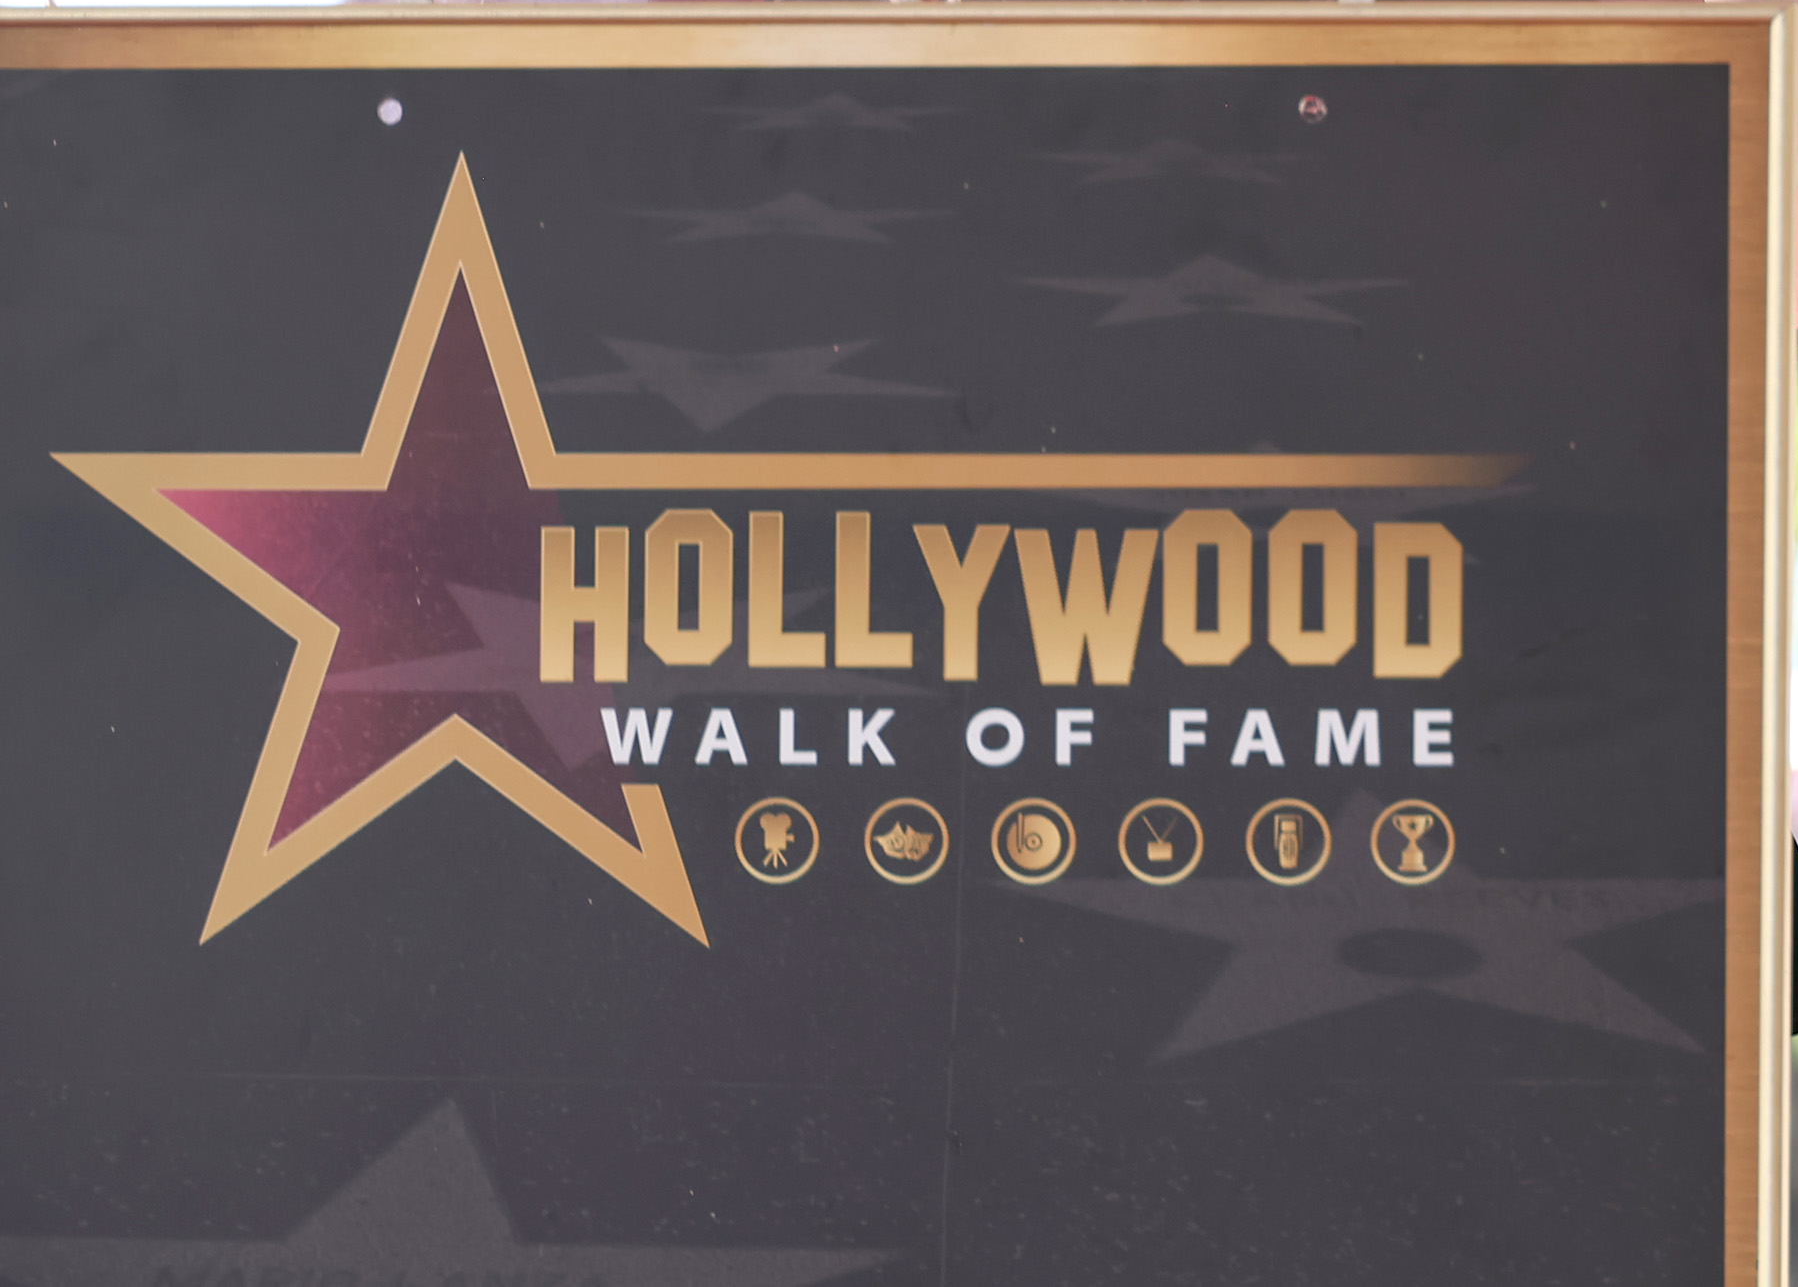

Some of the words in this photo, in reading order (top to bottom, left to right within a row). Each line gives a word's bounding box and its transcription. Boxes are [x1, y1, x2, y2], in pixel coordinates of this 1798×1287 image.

[540, 509, 1463, 685] HOLLYWOOD
[600, 708, 896, 766] WALK
[965, 708, 1094, 766] OF
[1169, 708, 1454, 766] FAME
